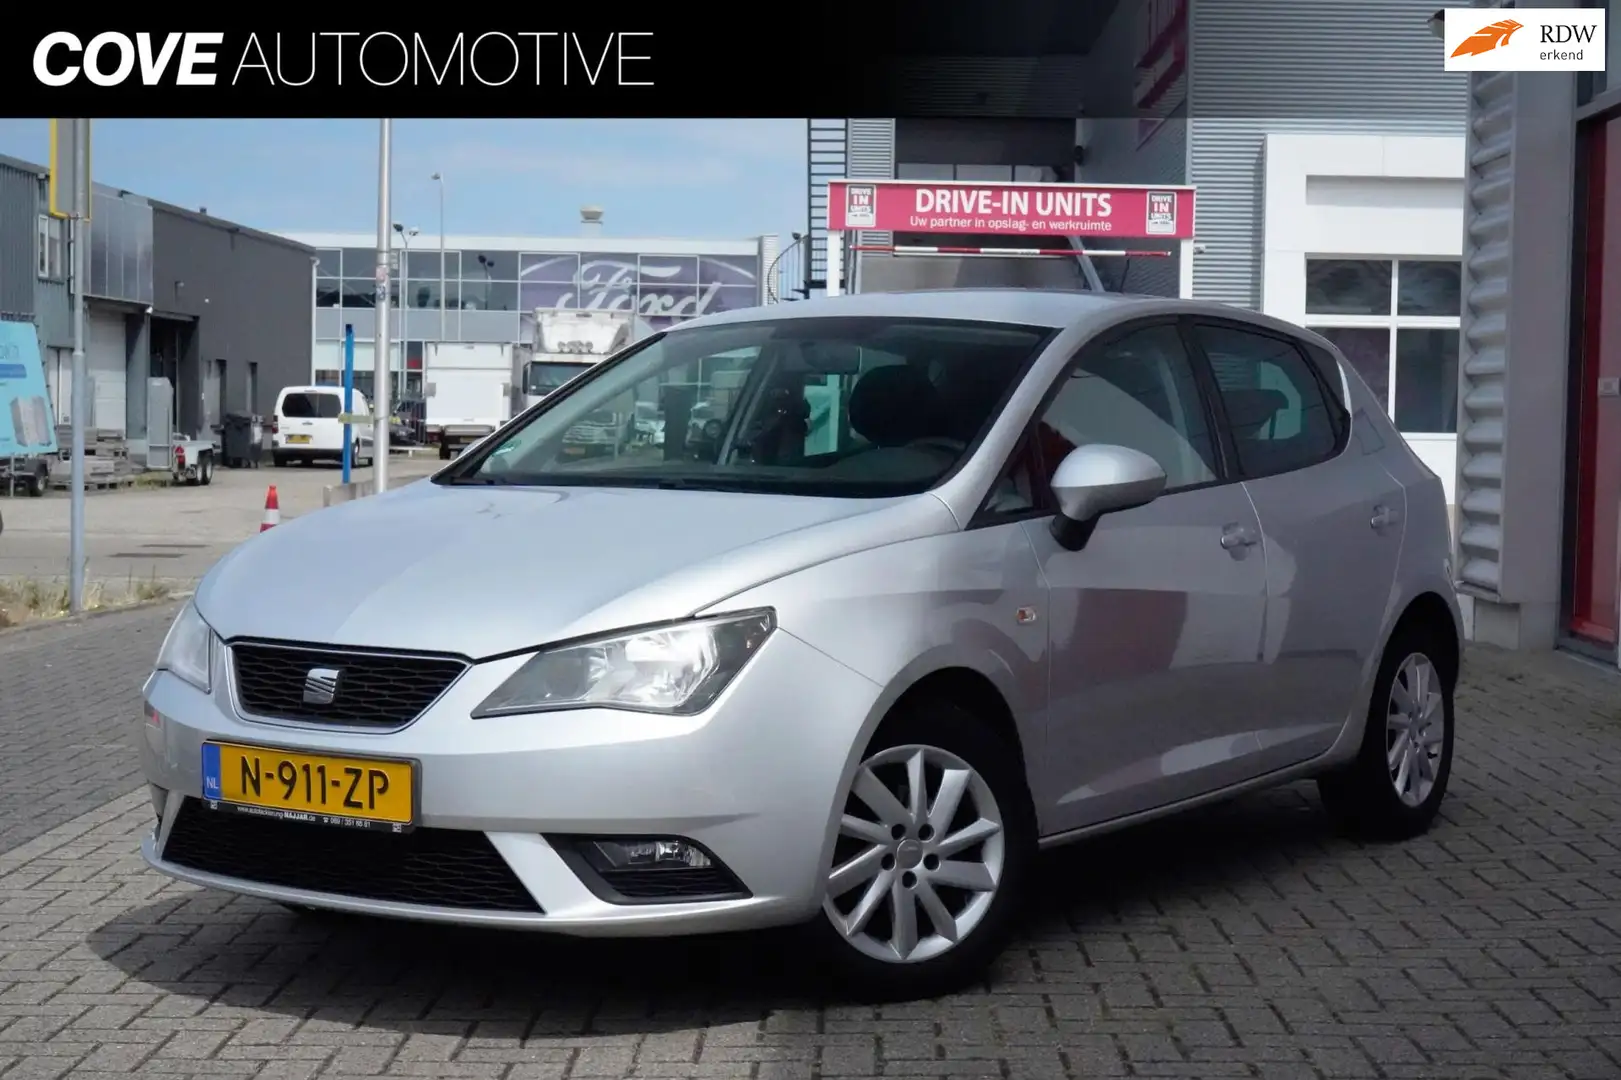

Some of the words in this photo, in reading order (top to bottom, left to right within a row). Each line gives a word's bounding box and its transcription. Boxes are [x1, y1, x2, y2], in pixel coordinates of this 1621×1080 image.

[853, 195, 869, 204] IN
[915, 188, 1029, 215] DRIVE-IN
[1036, 192, 1112, 217] UNITS
[1154, 202, 1169, 212] IN
[910, 216, 928, 226] Uw
[930, 216, 972, 229] partner
[975, 217, 985, 227] in
[987, 217, 1029, 231] opslag-
[1032, 221, 1047, 230] en
[1049, 219, 1112, 231] werkruimte
[206, 776, 220, 790] NL
[240, 755, 390, 810] N-911-ZP
